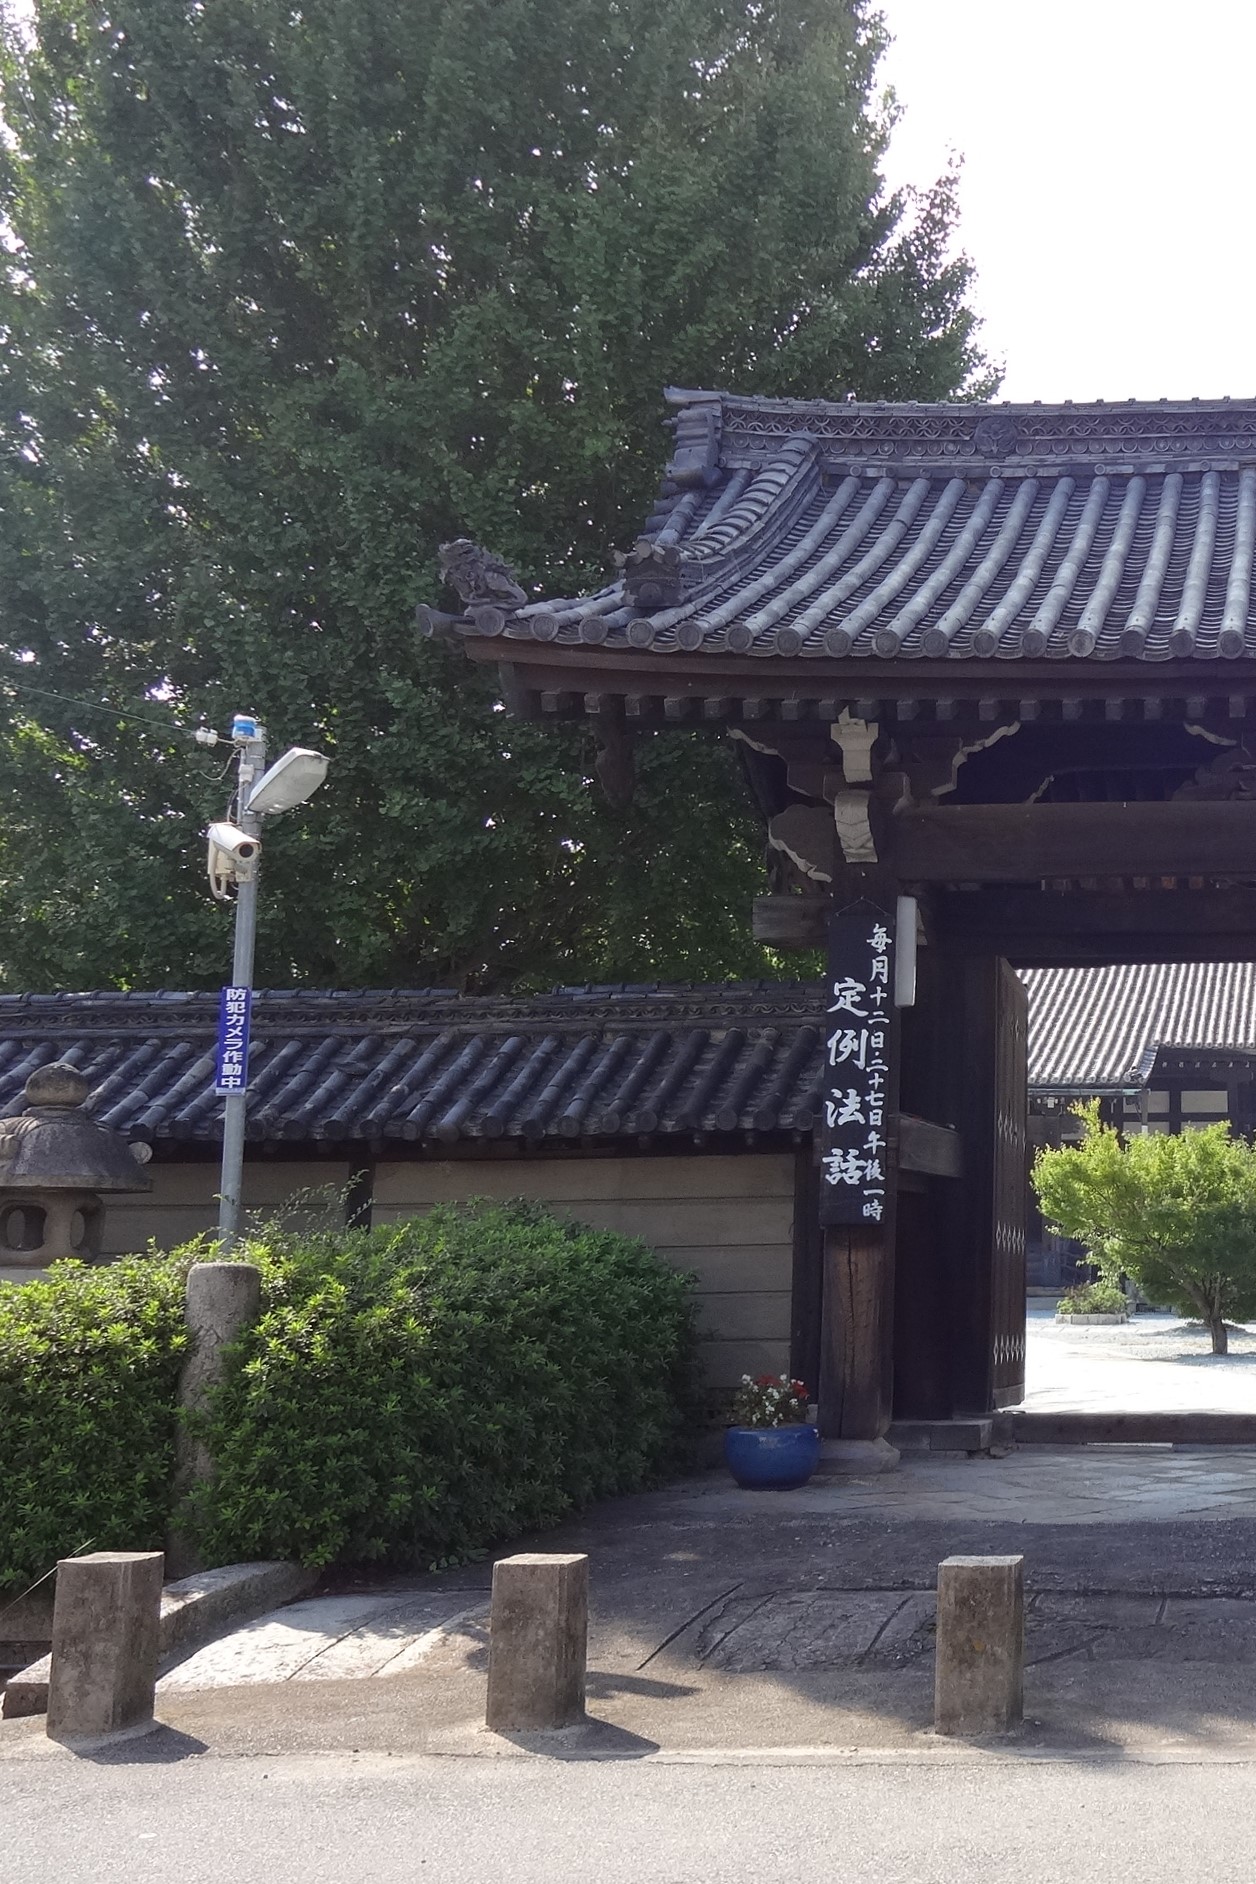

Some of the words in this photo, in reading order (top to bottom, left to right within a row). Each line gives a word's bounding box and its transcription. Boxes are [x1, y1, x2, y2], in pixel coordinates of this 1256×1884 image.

[221, 988, 247, 1089] 防犯カメラ作動中
[822, 976, 869, 1186] 定例法話
